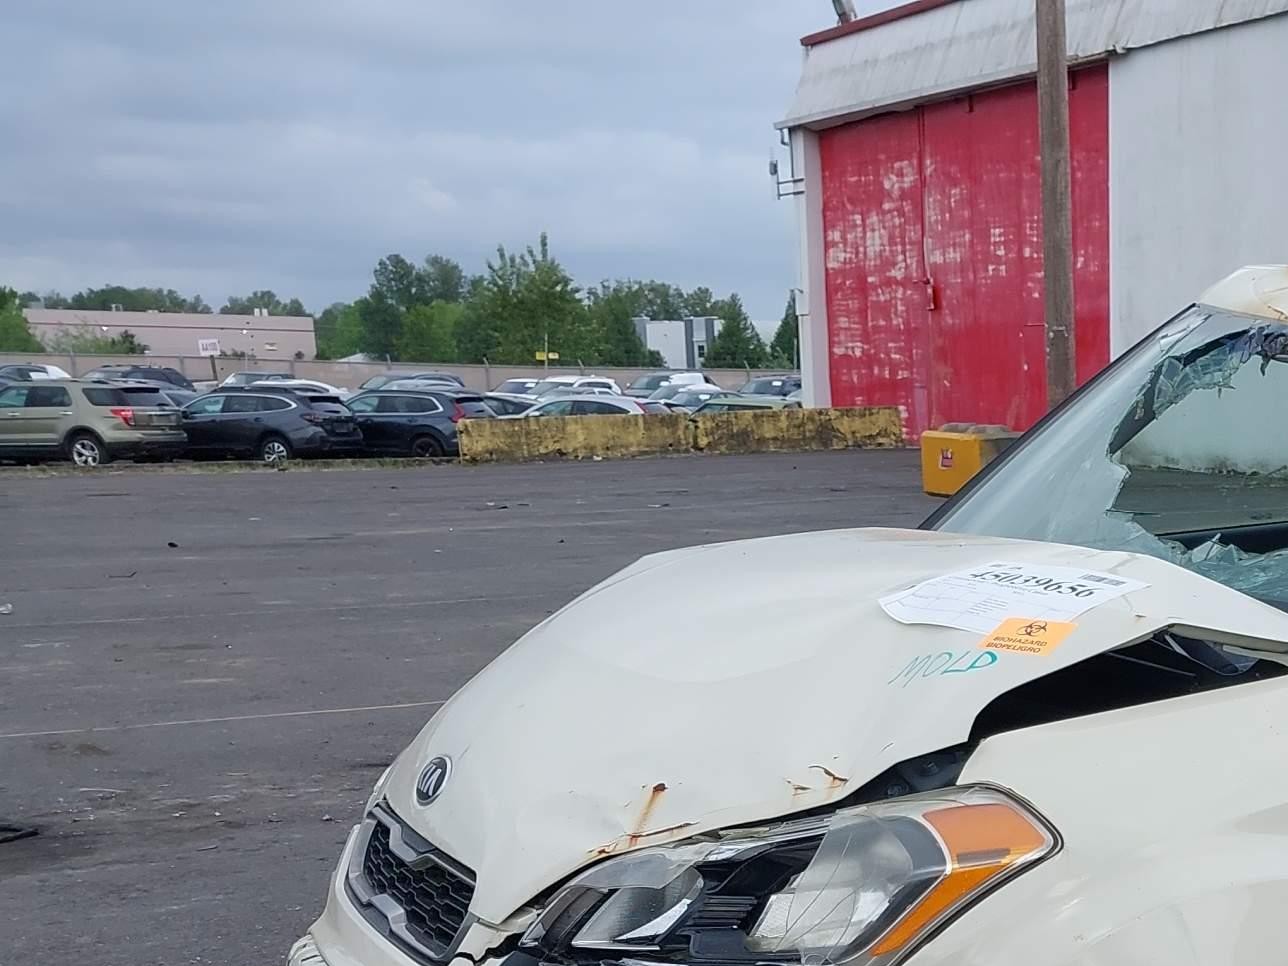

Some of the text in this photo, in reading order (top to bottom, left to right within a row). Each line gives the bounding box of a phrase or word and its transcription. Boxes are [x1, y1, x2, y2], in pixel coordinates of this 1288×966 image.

[985, 642, 1041, 654] BIOPELIGRO
[992, 636, 1048, 648] BIOHAZARD
[887, 650, 998, 688] MOLD
